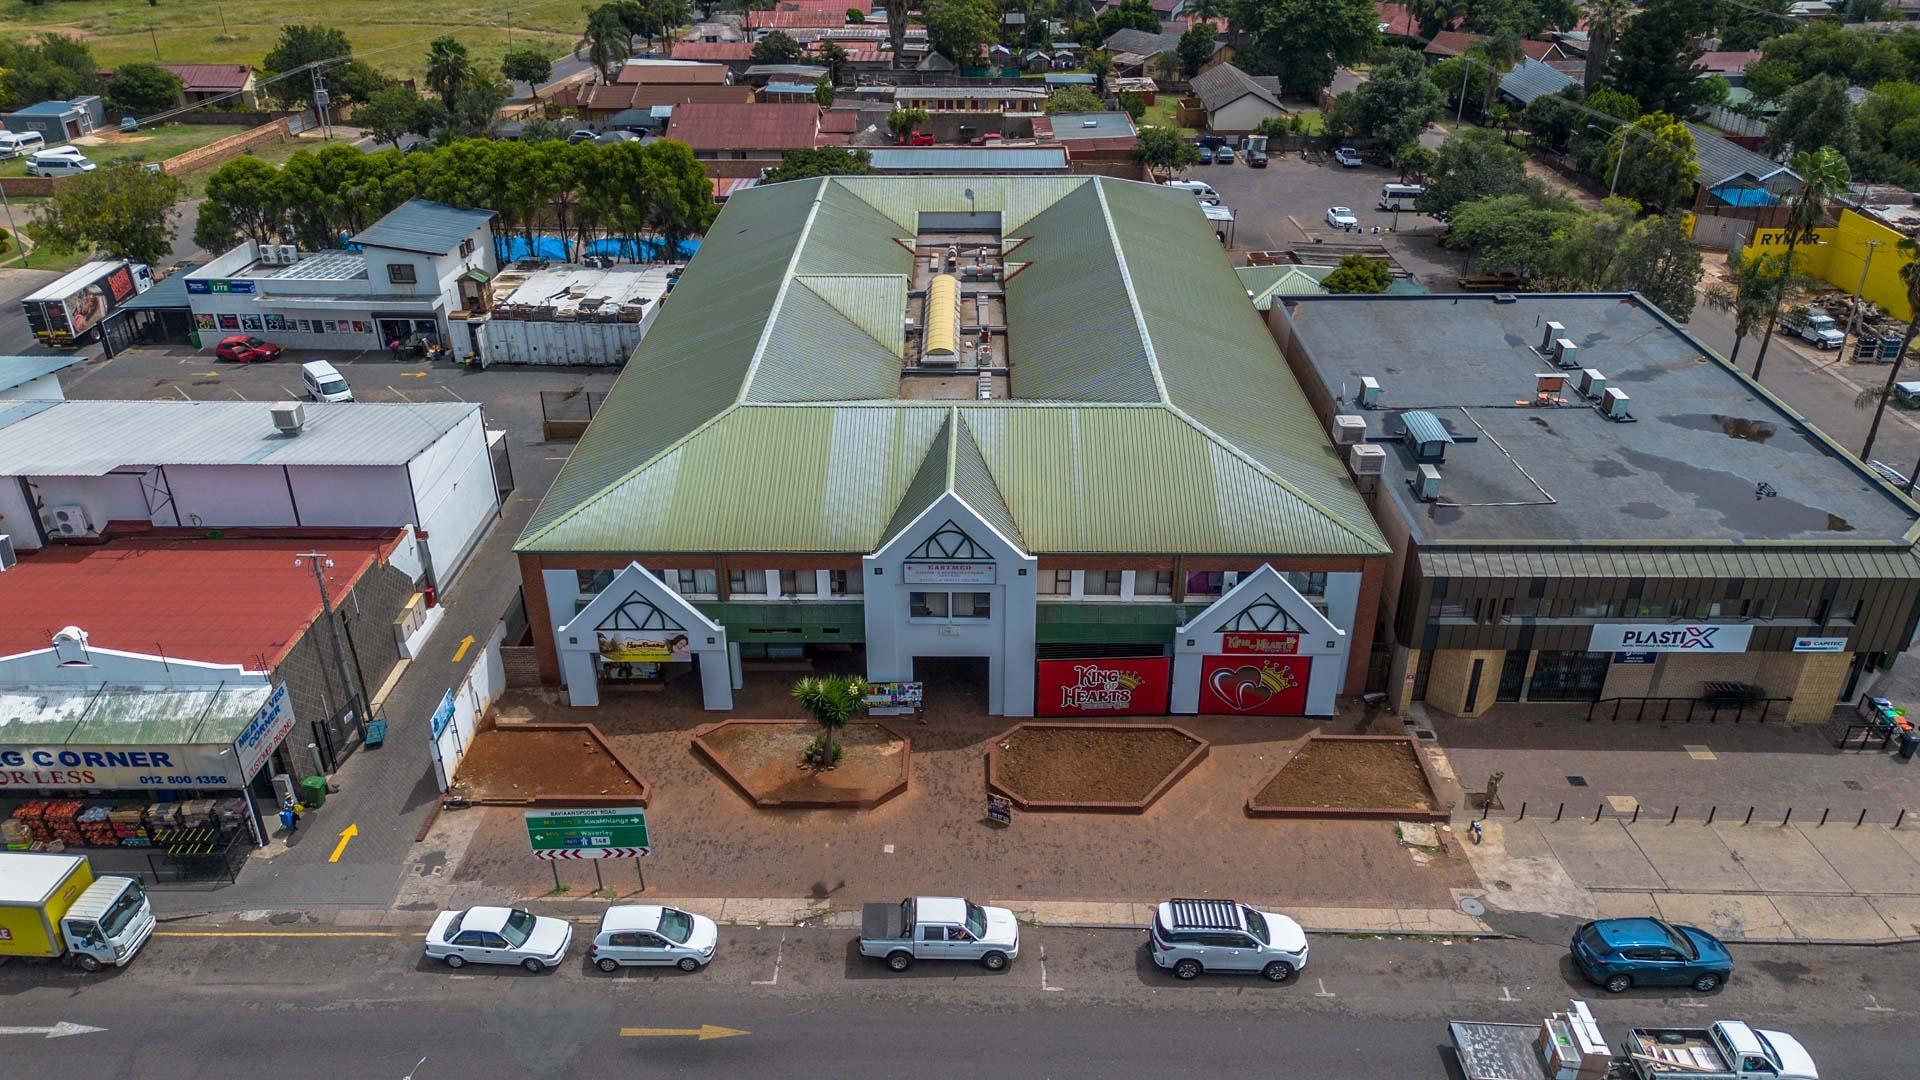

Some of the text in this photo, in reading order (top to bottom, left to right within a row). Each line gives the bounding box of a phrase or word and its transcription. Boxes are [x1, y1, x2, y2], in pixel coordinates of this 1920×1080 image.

[1622, 627, 1720, 648] PLASTIX
[1074, 665, 1120, 688] KING
[268, 685, 285, 708] VEG
[1061, 686, 1131, 707] HEARTS
[249, 704, 281, 748] CORNER
[0, 751, 173, 767] G CORNER
[36, 771, 96, 784] LESS
[140, 776, 227, 784] 012 800 1356
